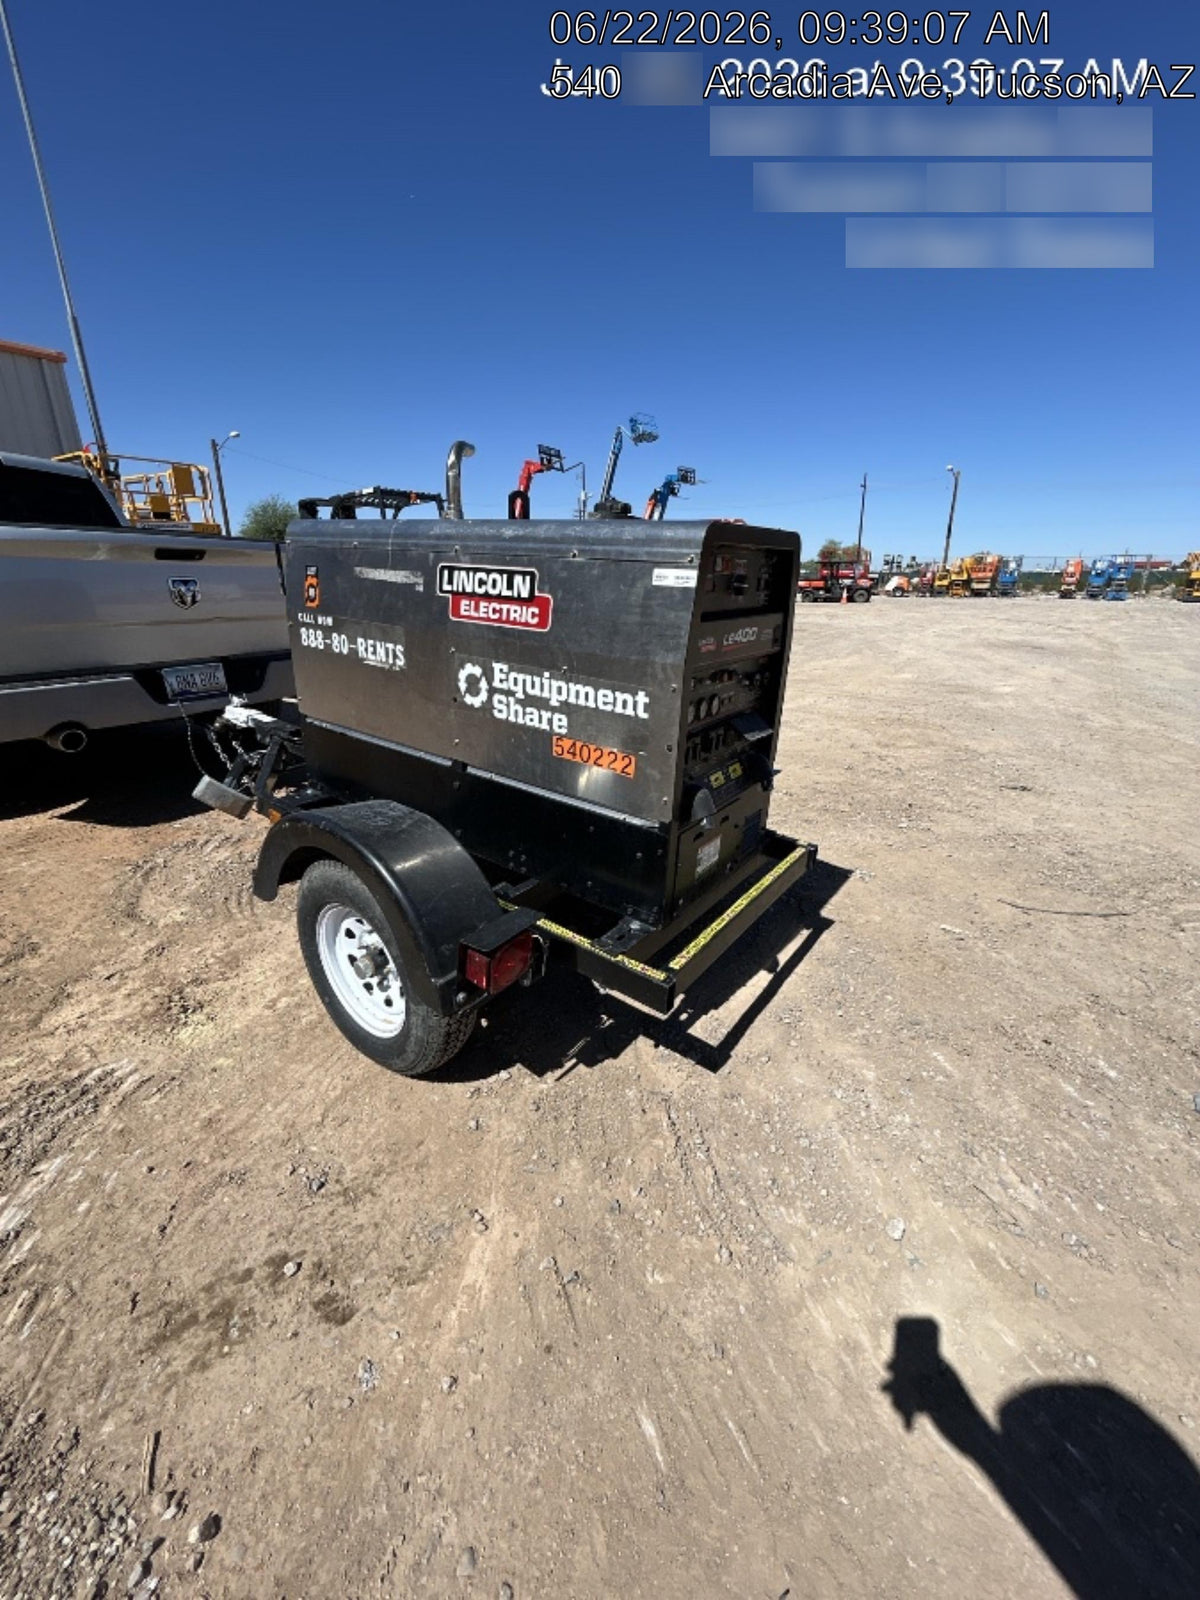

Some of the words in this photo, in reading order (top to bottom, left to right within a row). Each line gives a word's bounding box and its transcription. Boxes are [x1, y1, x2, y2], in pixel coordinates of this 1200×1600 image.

[442, 569, 530, 599] LINCOLN
[460, 599, 540, 624] ELECTRIC
[300, 627, 406, 666] 888-80-RENTS
[491, 661, 650, 719] Equipment
[492, 694, 568, 735] Share
[553, 737, 633, 777] 540222
